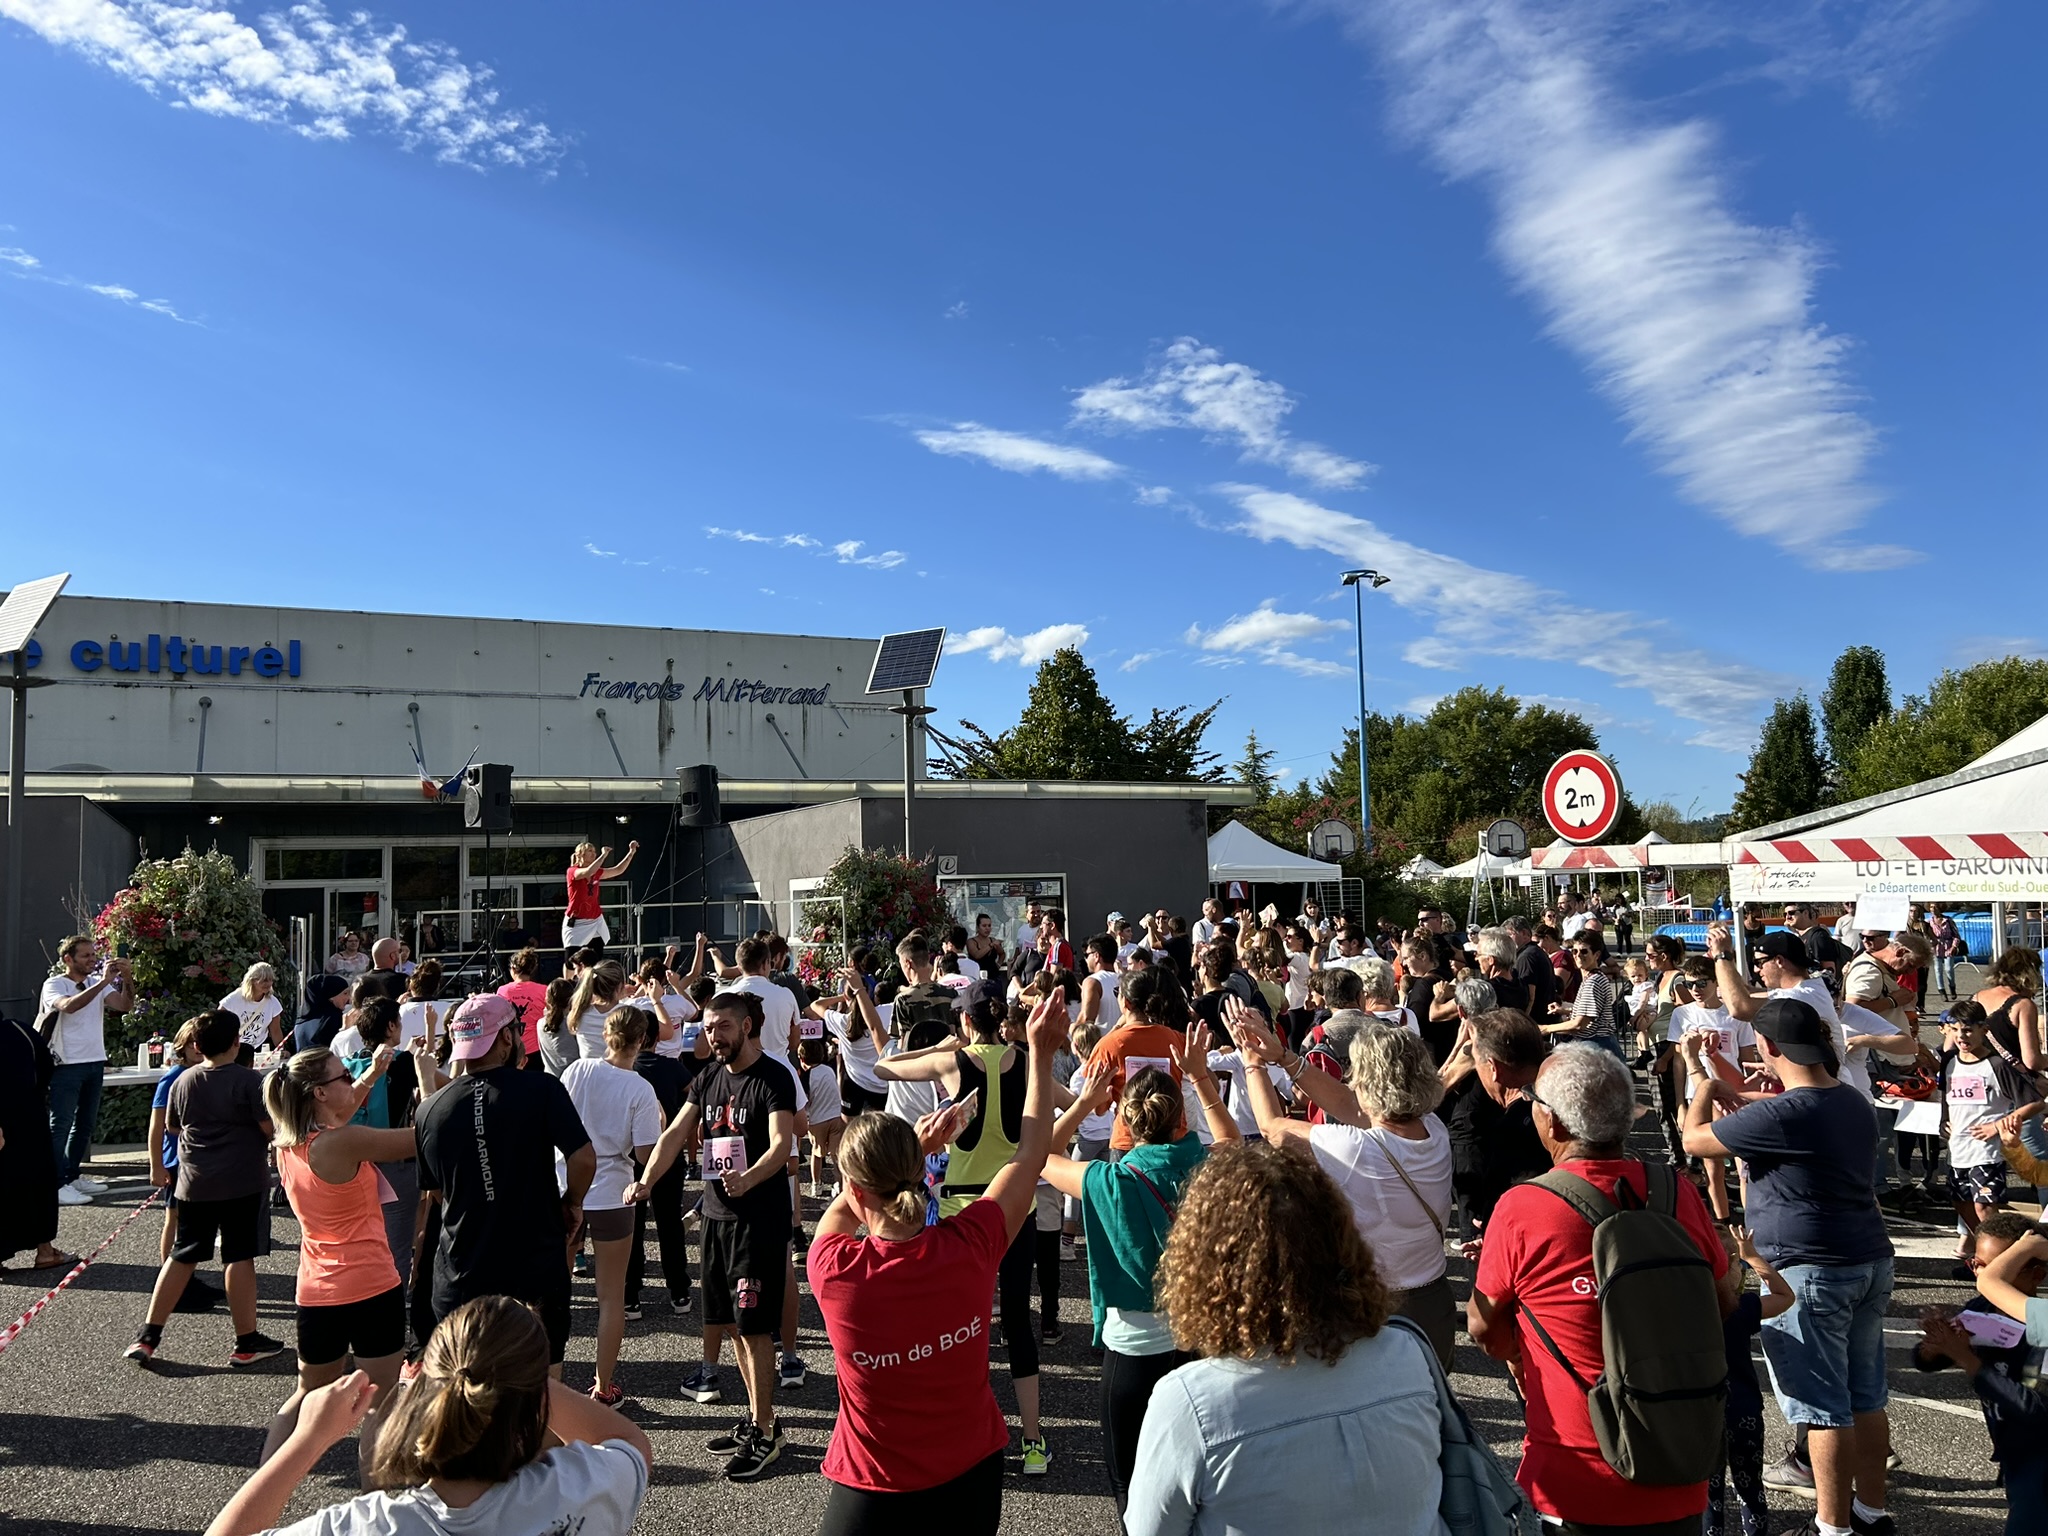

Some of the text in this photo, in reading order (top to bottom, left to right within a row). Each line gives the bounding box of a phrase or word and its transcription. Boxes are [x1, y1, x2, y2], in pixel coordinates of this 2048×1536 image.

[70, 634, 301, 678] culturel
[579, 672, 831, 705] François Mitterrand
[1768, 867, 1816, 879] Archers
[1856, 857, 2048, 877] LOT-ET-GARONN
[1865, 882, 1877, 893] Le
[1879, 882, 1947, 894] Département
[1948, 882, 1978, 893] Cœur
[1980, 880, 1995, 893] du
[1952, 1087, 1974, 1098] 116
[474, 1087, 495, 1202] UNDER ARMOUR
[708, 1156, 733, 1171] 160
[739, 1292, 758, 1308] 23
[852, 1316, 982, 1370] Gym de BOÉ
